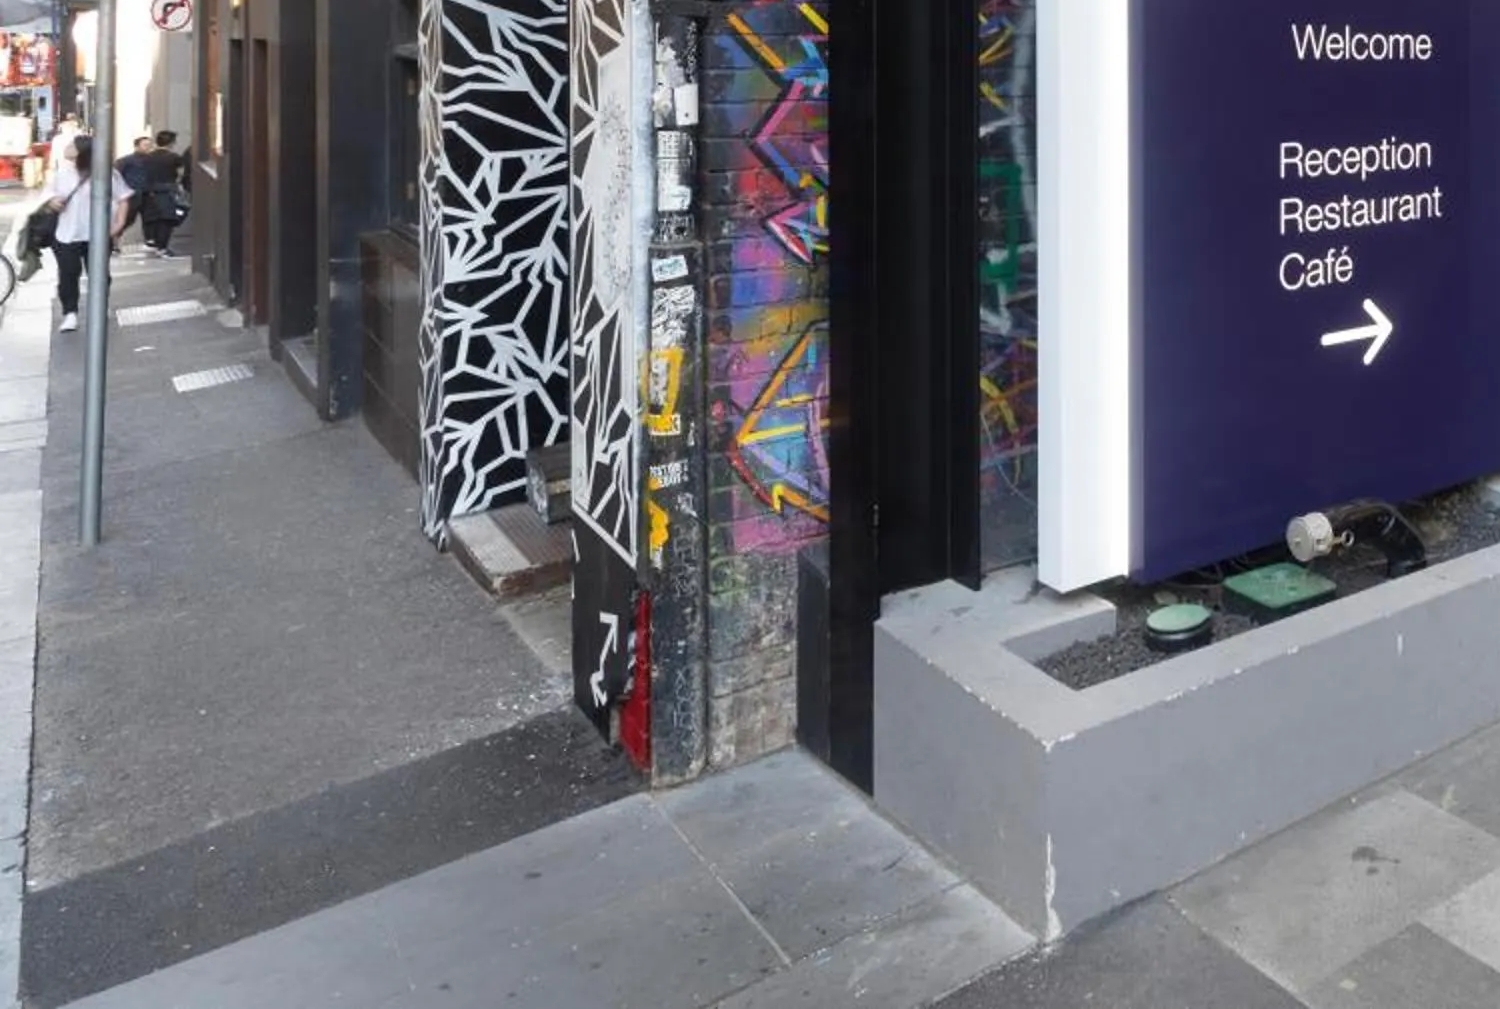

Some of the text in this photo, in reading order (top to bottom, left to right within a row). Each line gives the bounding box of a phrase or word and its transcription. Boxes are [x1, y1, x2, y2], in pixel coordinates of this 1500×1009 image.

[1291, 23, 1433, 61] Welcome
[1279, 136, 1432, 181] Reception
[1279, 186, 1443, 235] Restaurant
[1279, 246, 1354, 291] Café
